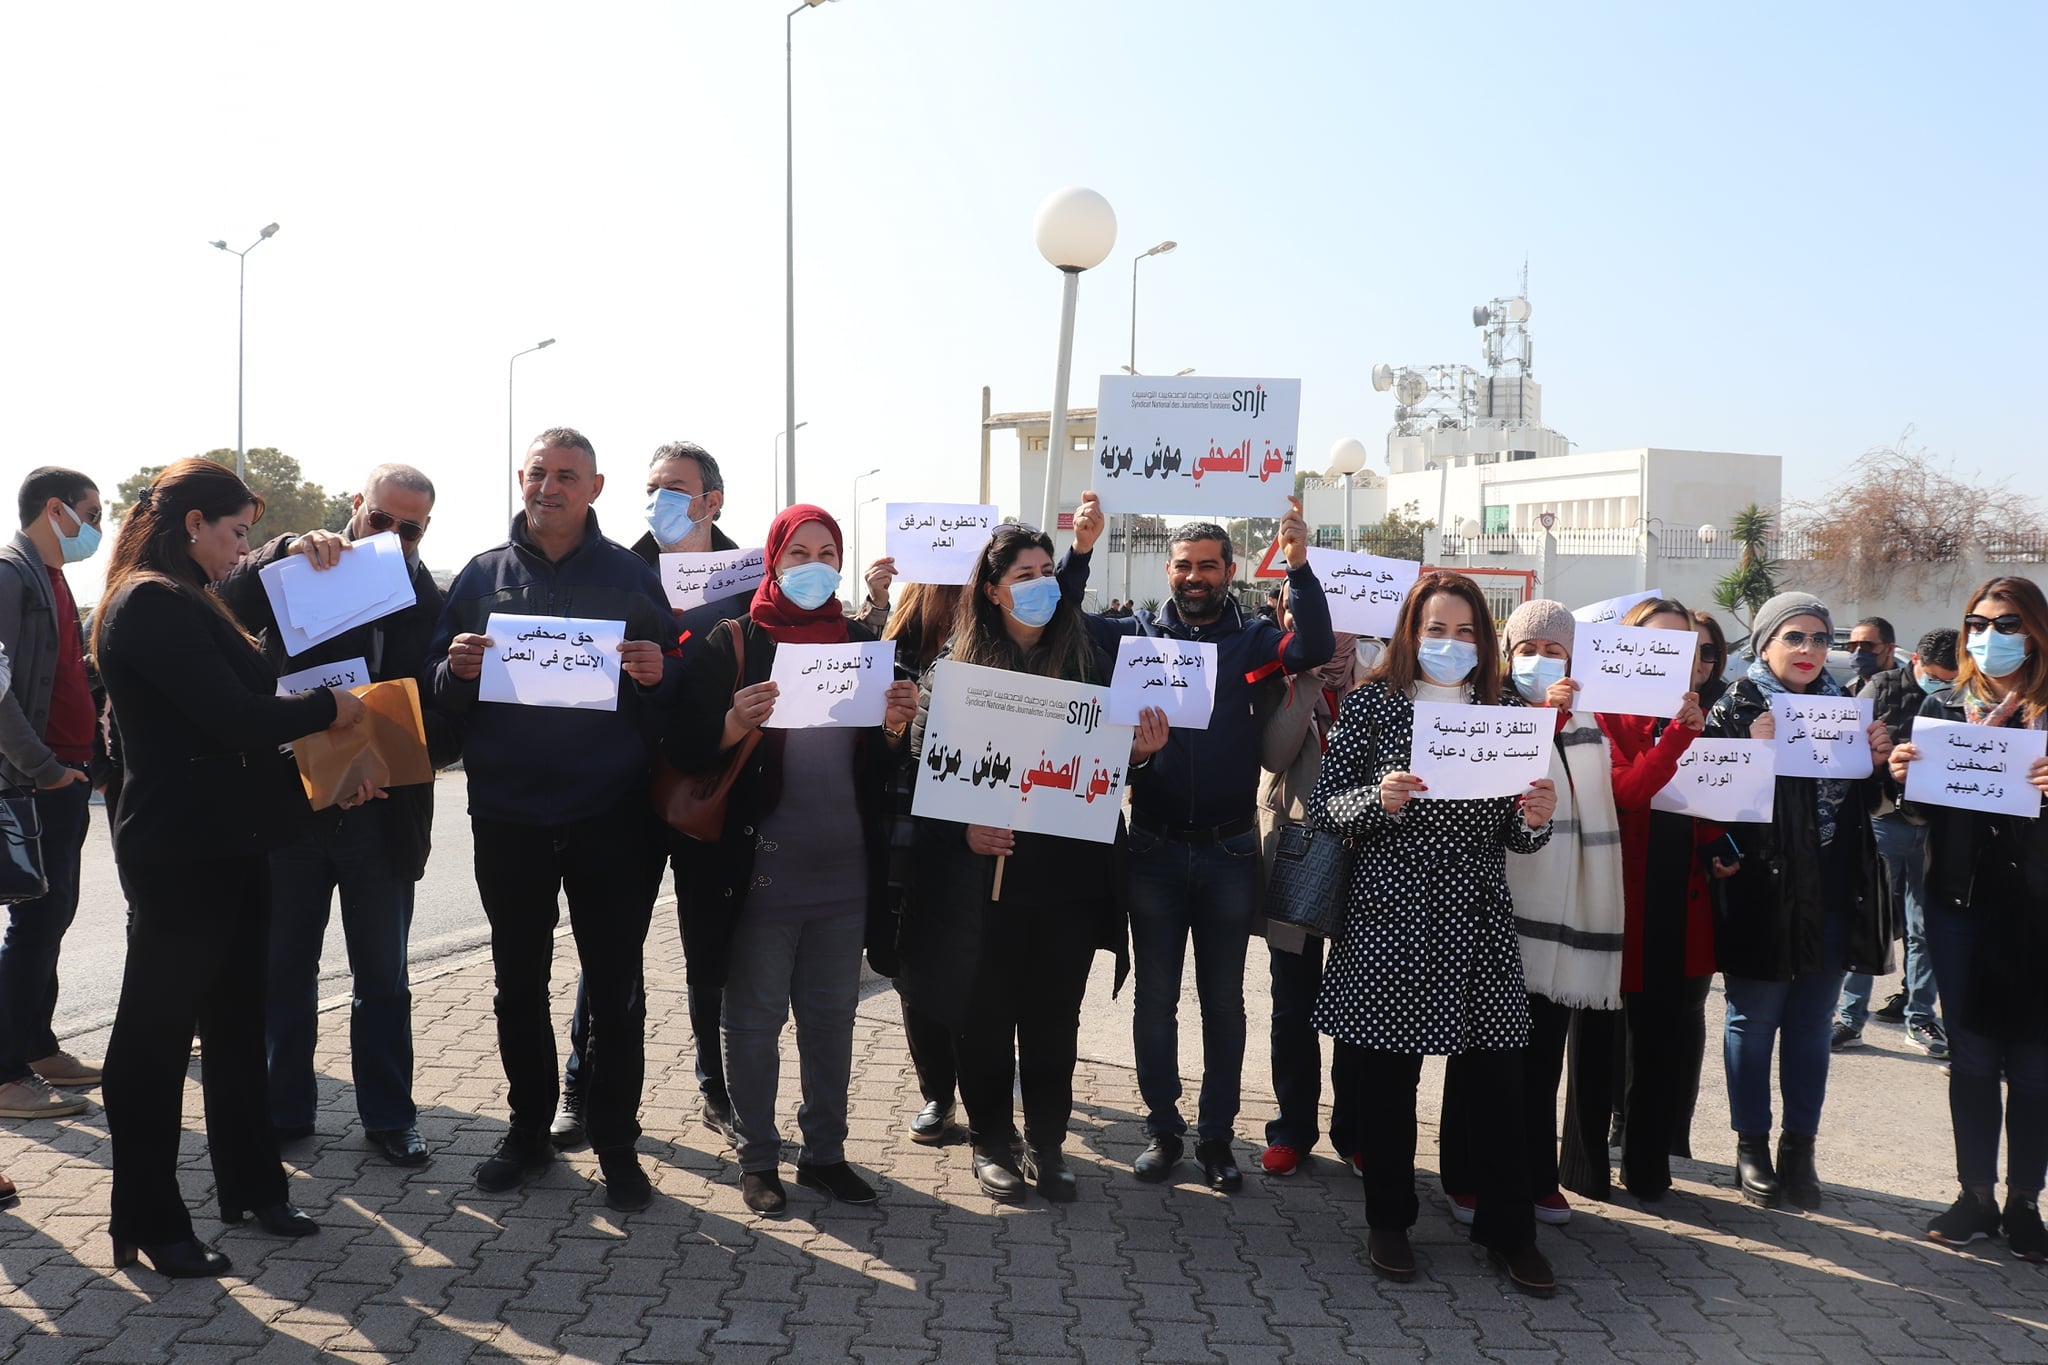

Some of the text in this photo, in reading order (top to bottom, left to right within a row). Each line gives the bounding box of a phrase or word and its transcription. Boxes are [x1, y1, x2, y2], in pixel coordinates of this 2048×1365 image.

[1232, 384, 1267, 419] snjt
[899, 514, 988, 532] لا لتطويع المرفق
[931, 537, 954, 552] العام
[678, 562, 726, 575] التونسية
[1331, 564, 1394, 583] حق صحفيي
[676, 579, 708, 594] دعاية
[712, 578, 735, 590] بوق
[1350, 585, 1366, 601] في
[1369, 588, 1403, 604] الإنتاج
[517, 626, 594, 646] حق صحفيي
[1649, 640, 1680, 655] سلطة
[501, 648, 604, 672] الإنتاج في العمل
[801, 656, 873, 675] لا للعودة إلى
[1128, 653, 1205, 671] الإعلام العمومي
[1601, 659, 1665, 678] سلطة راكعة
[345, 672, 355, 683] لا
[1142, 673, 1188, 689] خط أحمر
[817, 680, 853, 694] الوراء
[965, 697, 986, 707] Syndicat
[986, 699, 1006, 711] National
[1006, 703, 1015, 712] des
[1066, 696, 1102, 734] snjt
[1785, 707, 1861, 723] التلفزة حرة حرة
[1433, 717, 1536, 738] التلفزة التونسية
[1811, 727, 1843, 741] المكلفة
[1787, 729, 1806, 744] على
[1428, 741, 1539, 762] ليست بوق دعاية
[1999, 742, 2008, 753] لا
[1680, 751, 1751, 766] لا للعودة إلى
[1813, 750, 1828, 763] برة
[1947, 758, 2007, 773] الصحفيين
[1697, 773, 1732, 786] الوراء
